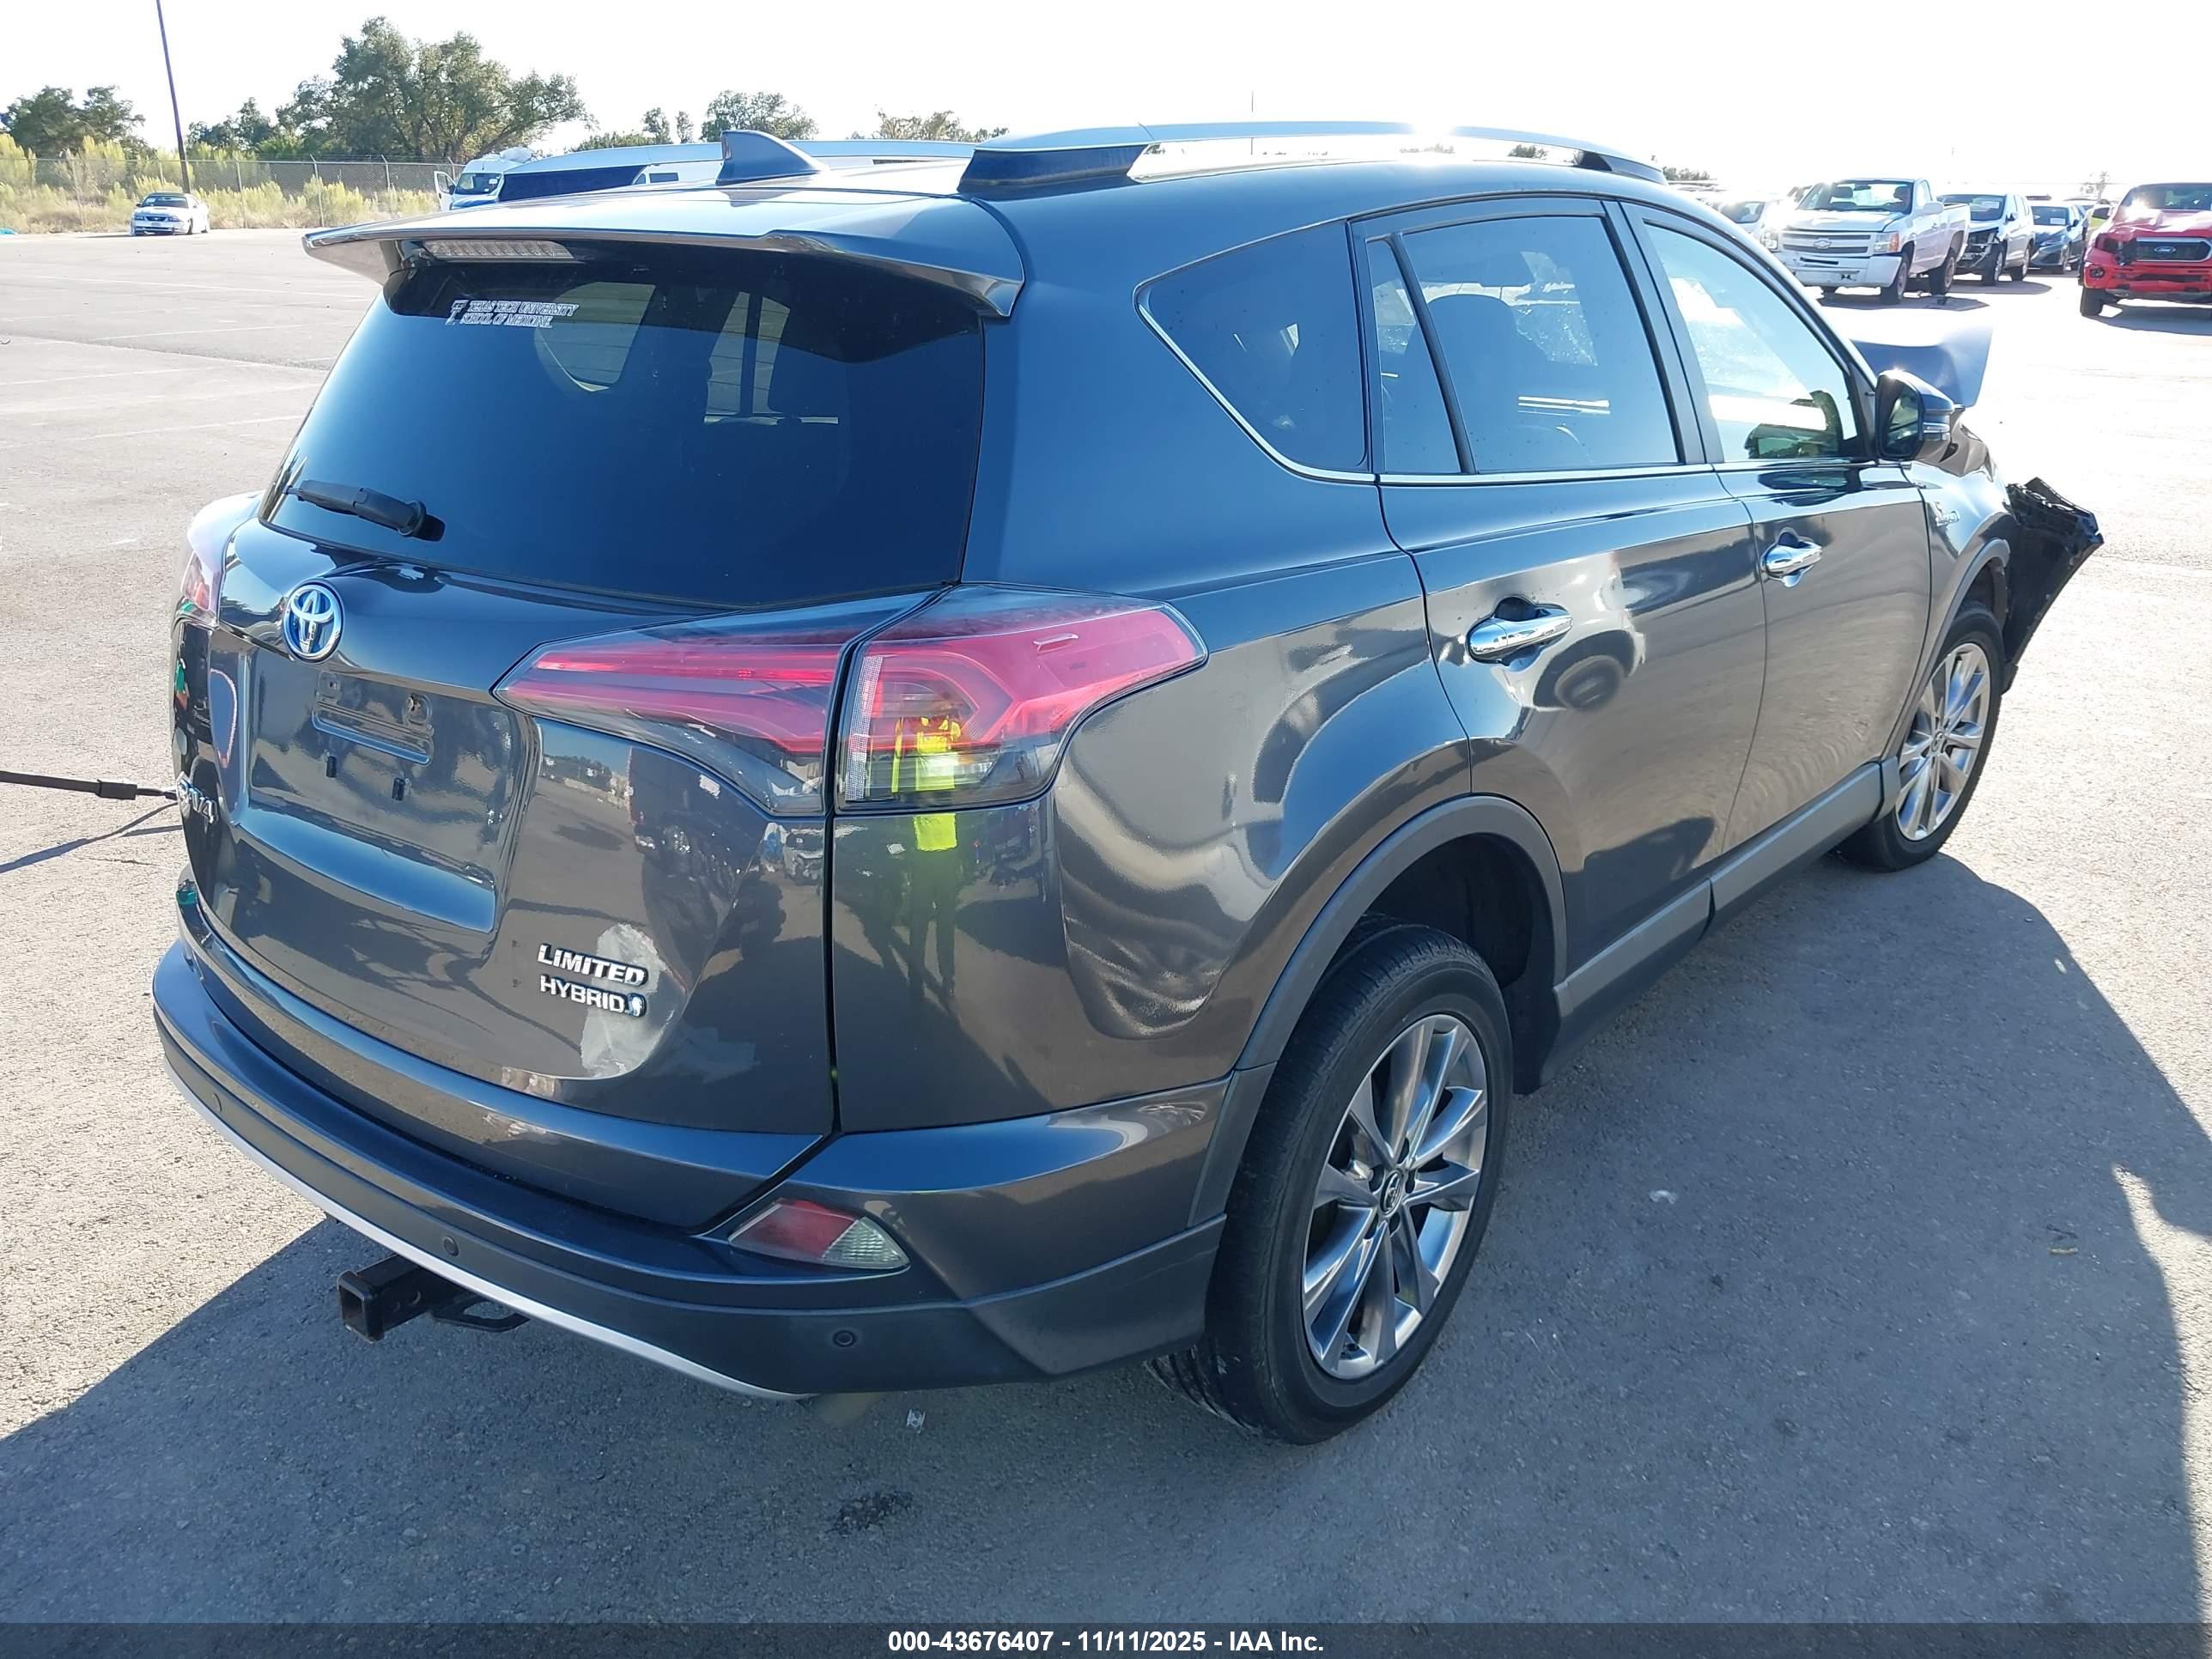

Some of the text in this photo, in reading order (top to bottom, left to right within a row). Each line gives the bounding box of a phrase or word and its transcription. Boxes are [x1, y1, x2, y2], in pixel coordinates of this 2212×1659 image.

[459, 312, 554, 329] SCHOOL OF MEDICINE
[467, 300, 580, 317] TEXAS TECH UNIVERSITY
[537, 943, 648, 987] LIMITED
[539, 974, 627, 1014] HYBRID
